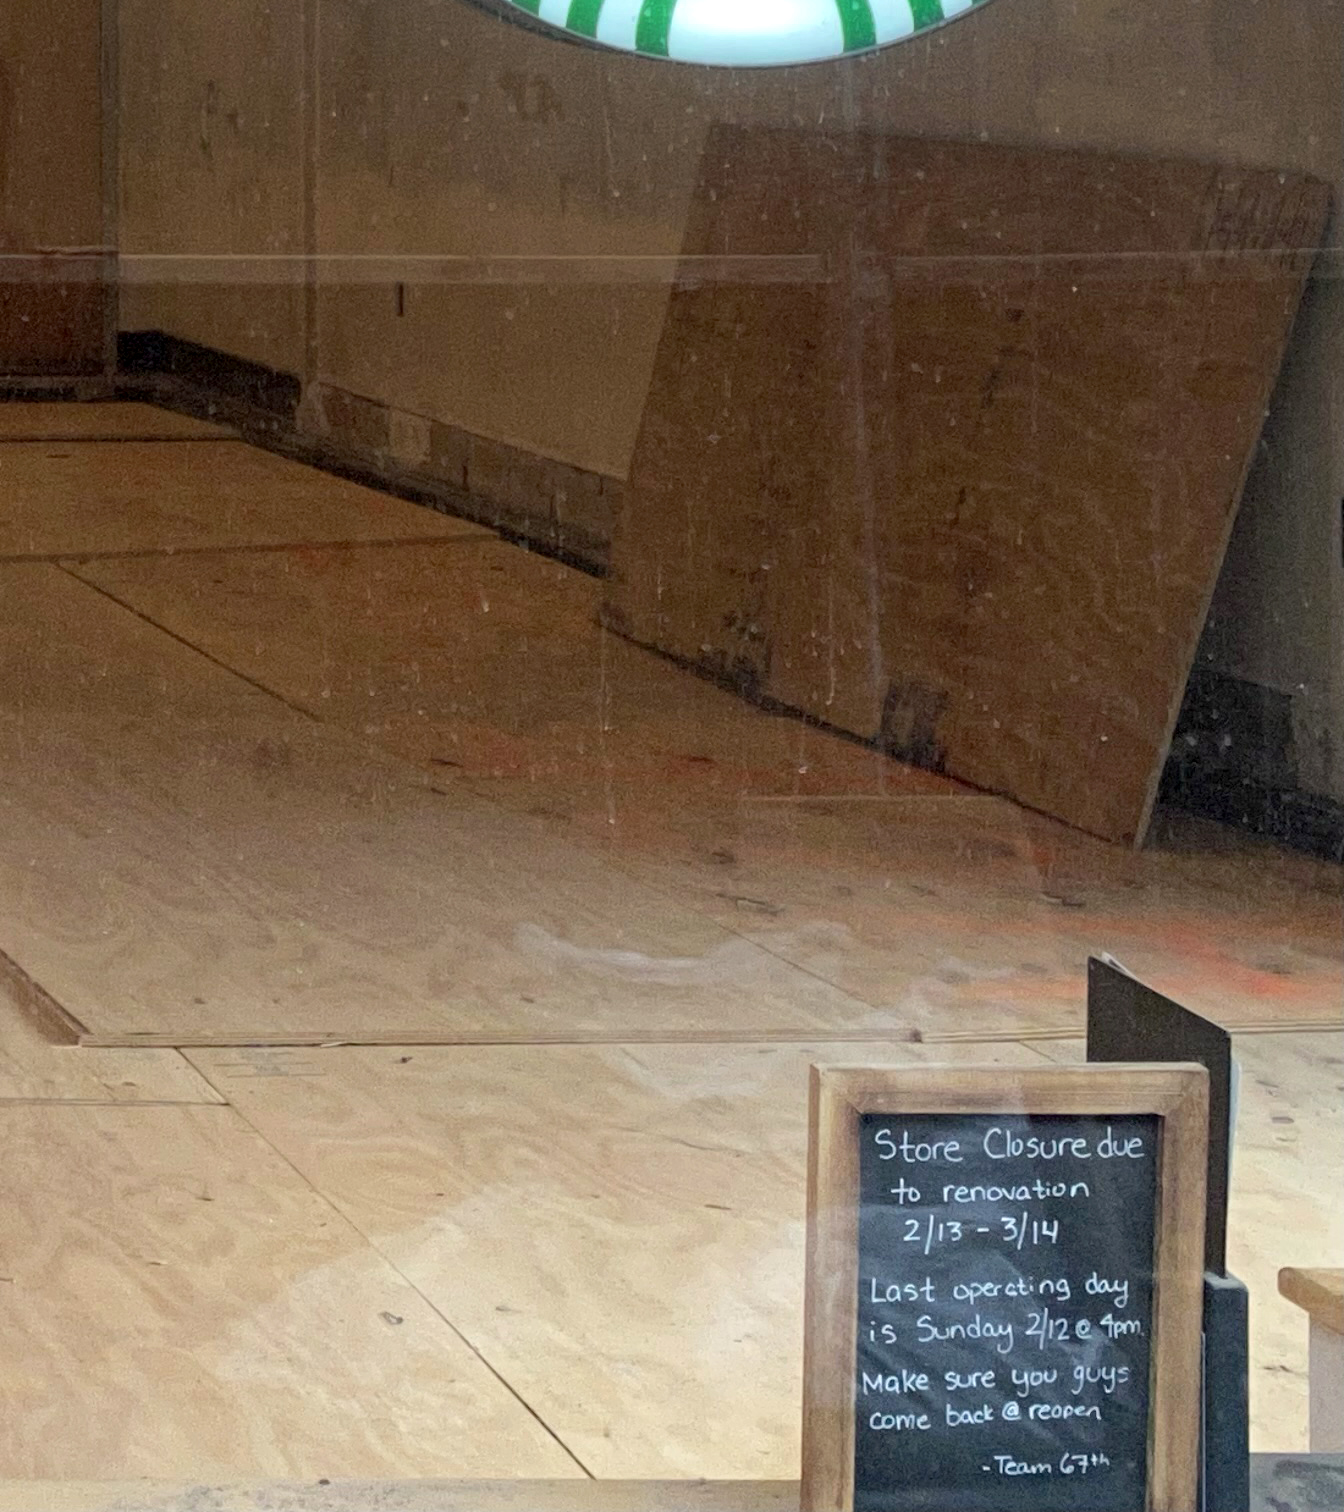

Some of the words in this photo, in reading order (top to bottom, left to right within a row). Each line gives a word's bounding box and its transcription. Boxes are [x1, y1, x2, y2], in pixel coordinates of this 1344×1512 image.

[874, 1128, 964, 1163] Store
[983, 1127, 1092, 1160] Closure
[1097, 1125, 1146, 1159] due
[890, 1177, 922, 1205] to
[942, 1178, 1090, 1203] renovation
[902, 1213, 963, 1255] 2/13
[1000, 1211, 1060, 1251] 3/14
[870, 1276, 936, 1304] Last
[952, 1276, 1072, 1305] operating
[1084, 1271, 1129, 1308] day
[869, 1320, 898, 1345] is
[916, 1313, 1014, 1354] Sunday
[1024, 1307, 1070, 1350] 2/12
[1074, 1319, 1093, 1340] @
[861, 1368, 930, 1396] Make
[944, 1368, 996, 1392] sure
[1011, 1367, 1059, 1399] you
[1070, 1365, 1130, 1395] guys
[869, 1411, 932, 1431] come
[946, 1403, 994, 1427] back
[1001, 1401, 1022, 1421] @
[1028, 1403, 1102, 1421] reopen
[1059, 1452, 1111, 1475] 67th
